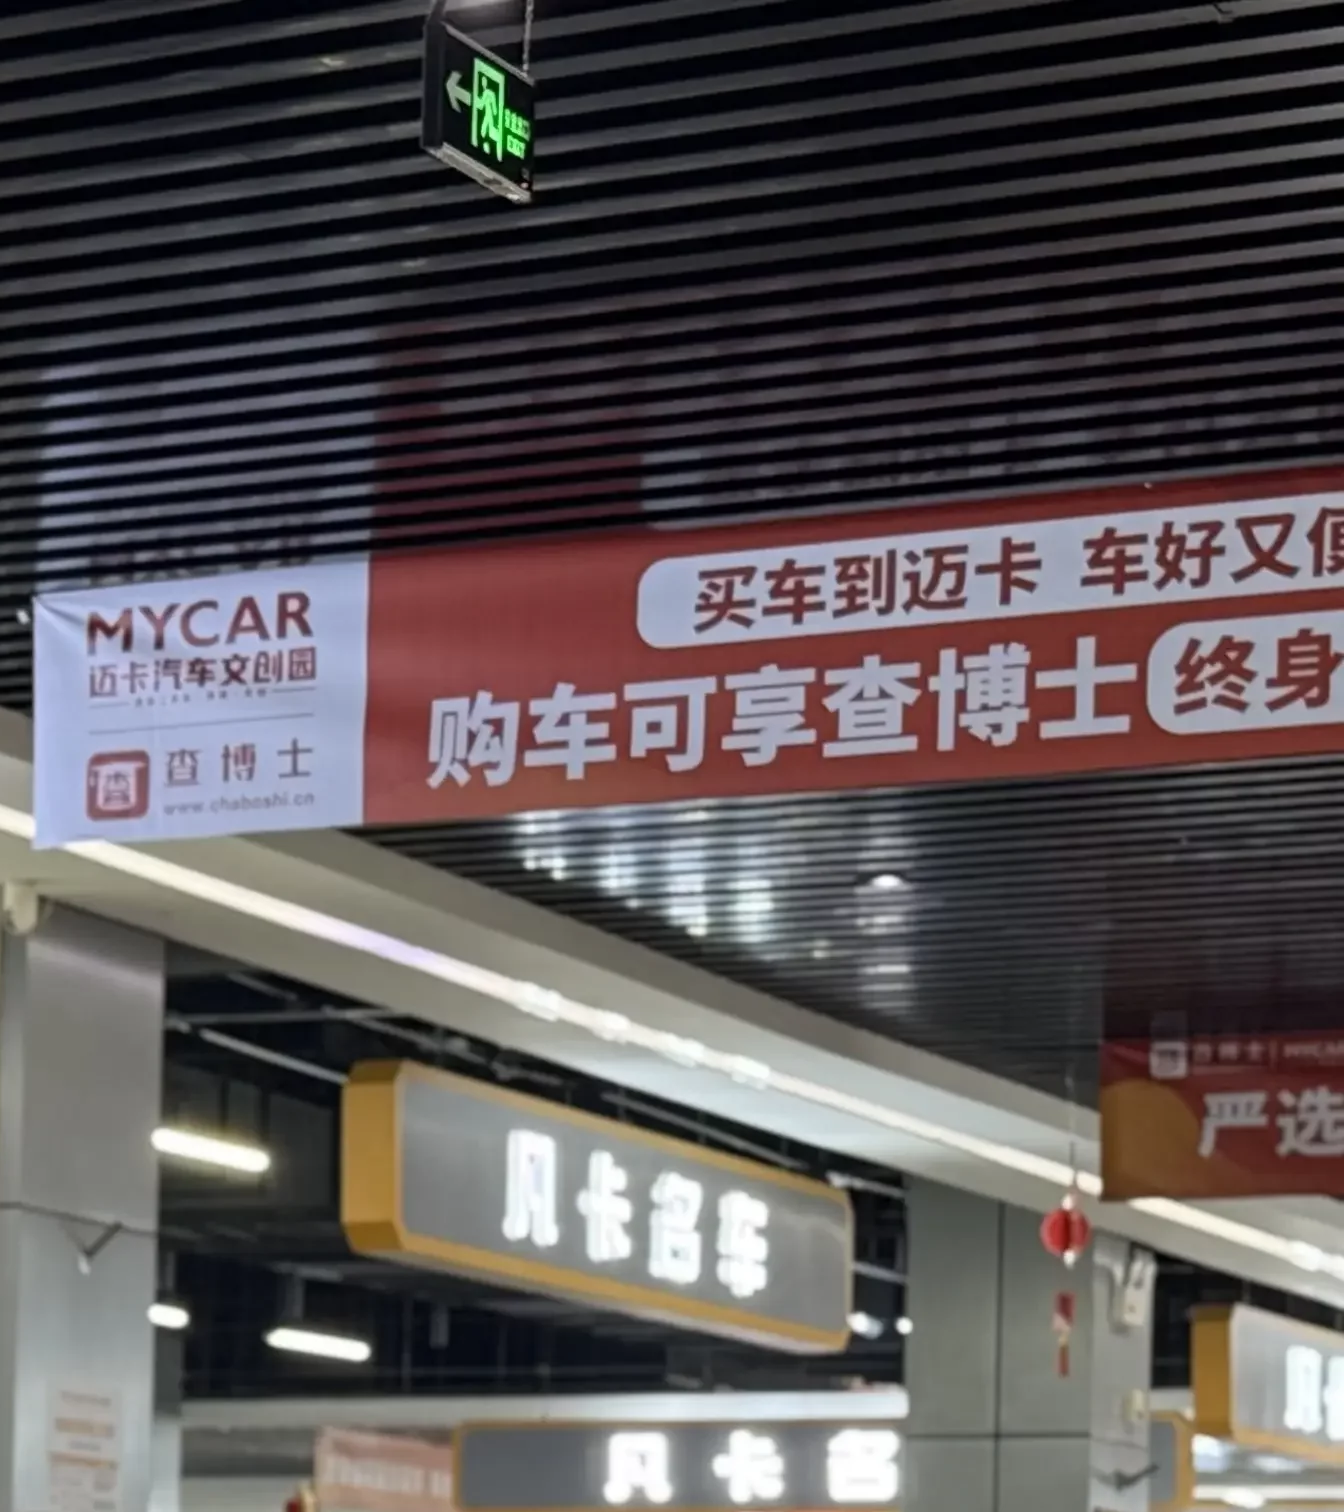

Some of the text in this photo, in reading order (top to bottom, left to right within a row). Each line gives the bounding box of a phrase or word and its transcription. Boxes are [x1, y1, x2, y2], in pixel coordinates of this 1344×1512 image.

[693, 536, 1043, 634] 买车到迈卡
[87, 591, 314, 656] MYCAR
[88, 645, 317, 699] 迈卡汽车文创园
[426, 635, 1138, 791] 购车可享查博士
[163, 791, 315, 817] www.chaboshi.cn
